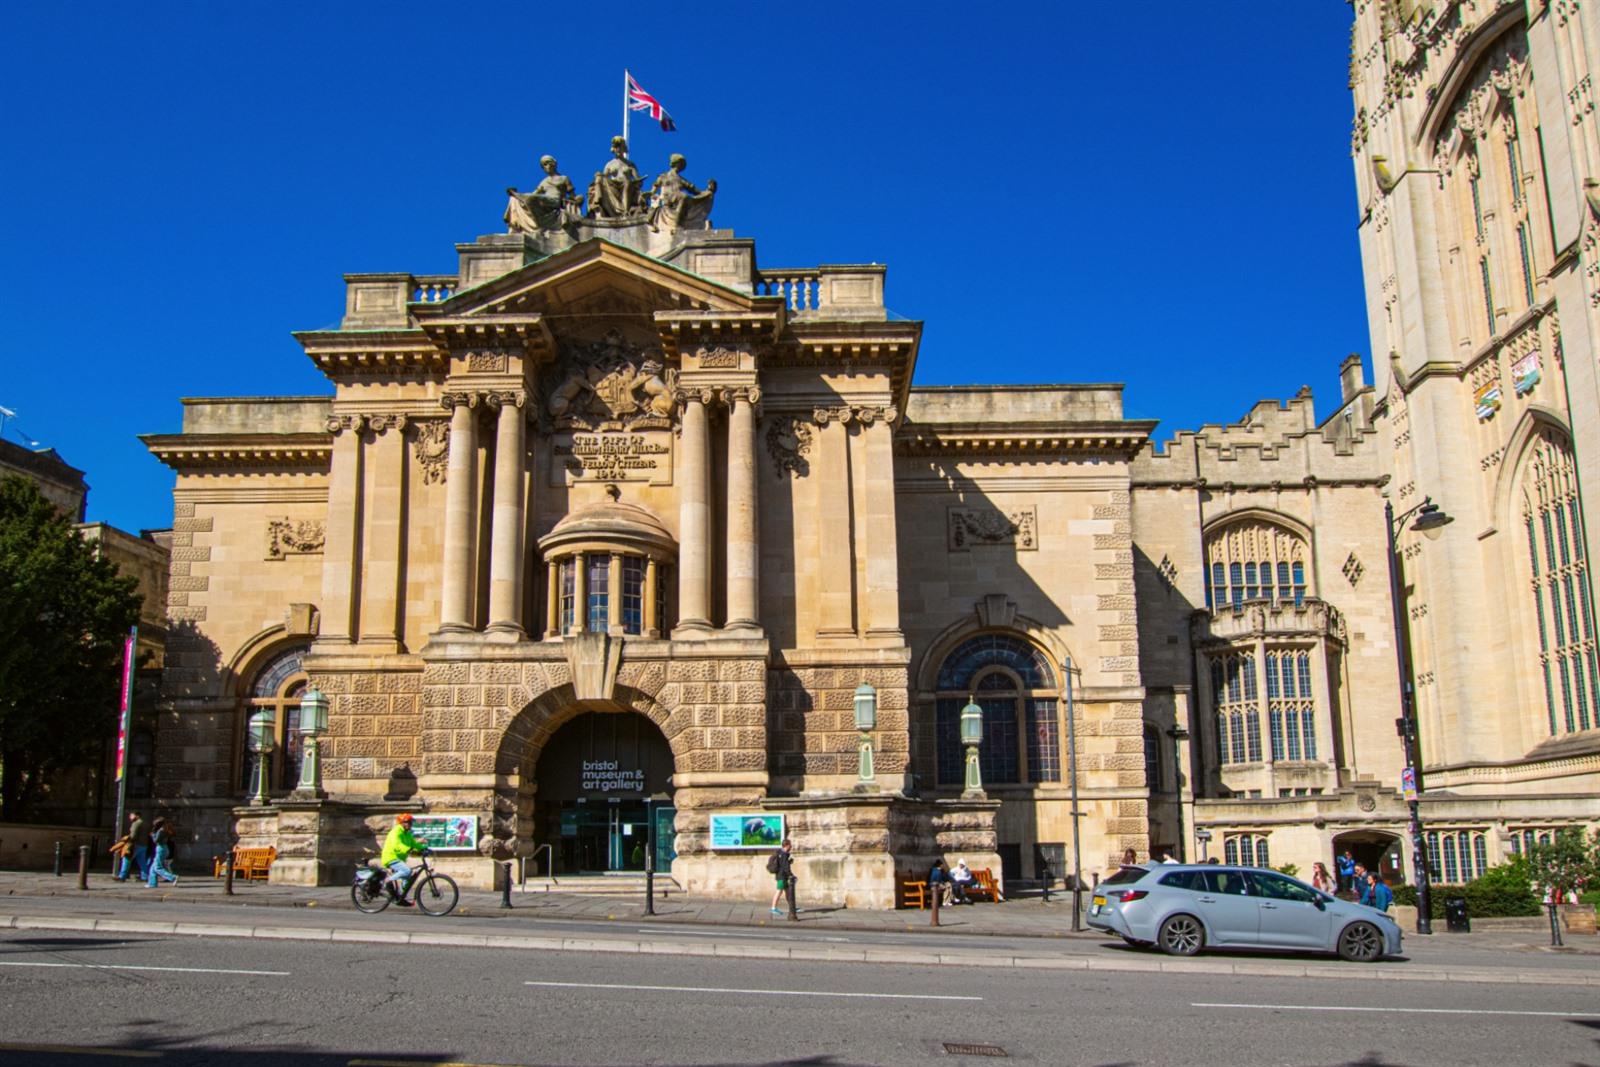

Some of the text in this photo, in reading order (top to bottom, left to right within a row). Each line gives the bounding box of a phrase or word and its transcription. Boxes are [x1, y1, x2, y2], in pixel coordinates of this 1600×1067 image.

[583, 760, 618, 770] bristol
[583, 769, 644, 779] museum &
[583, 779, 644, 791] art gallery
